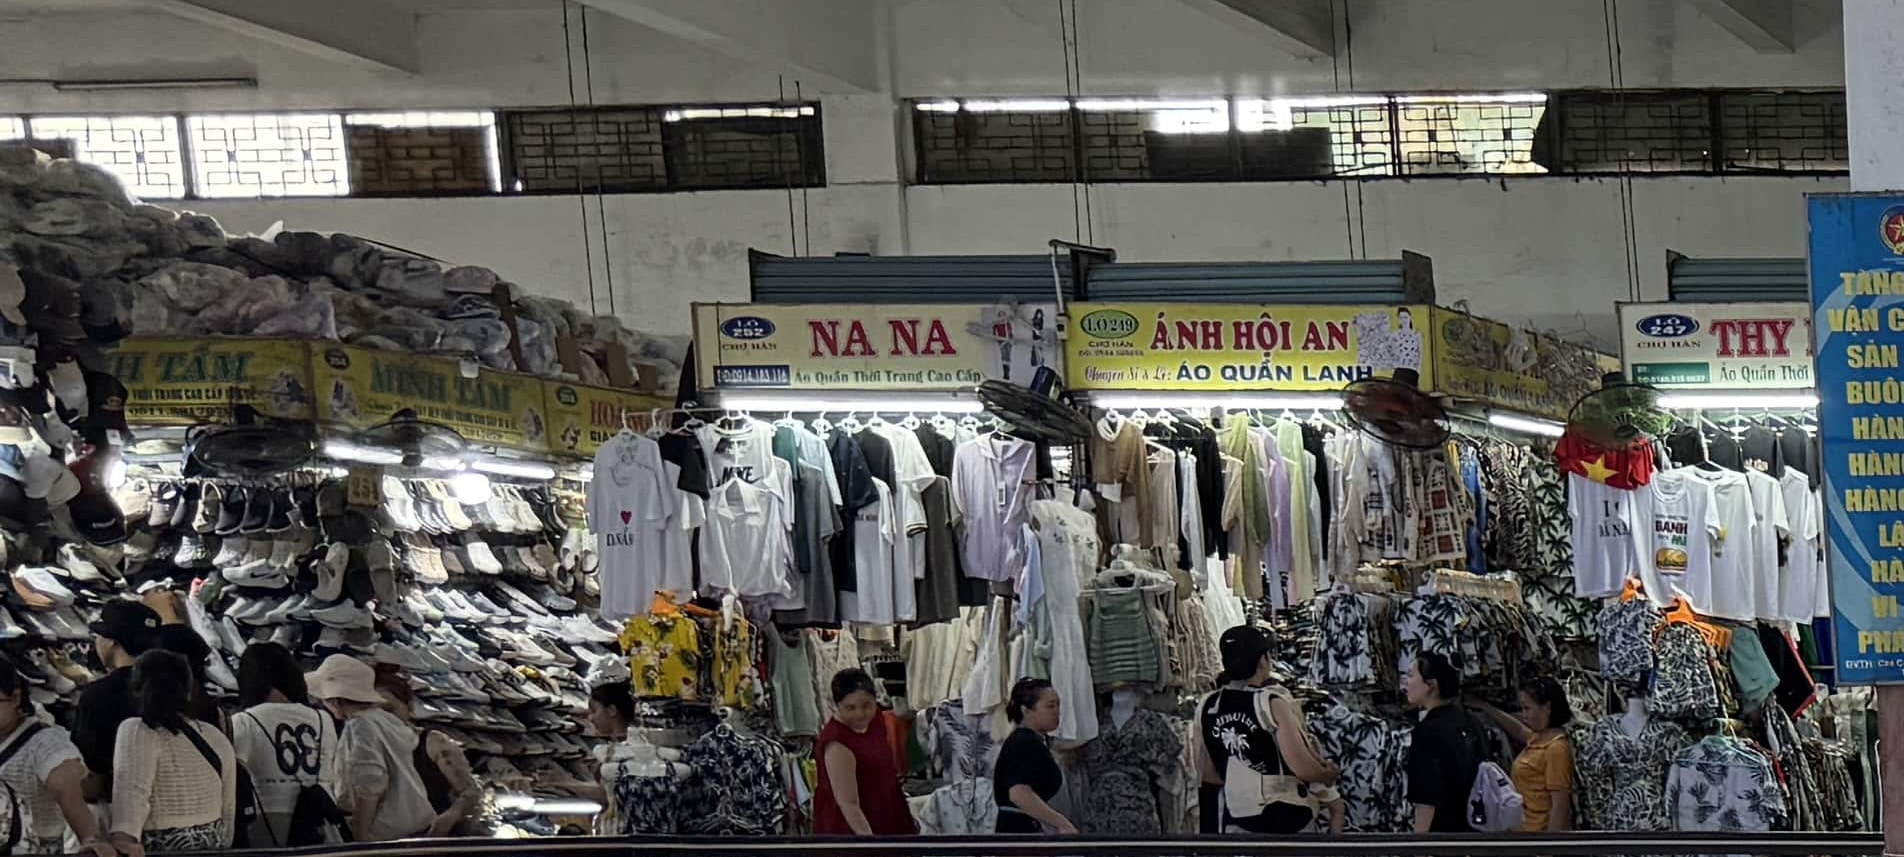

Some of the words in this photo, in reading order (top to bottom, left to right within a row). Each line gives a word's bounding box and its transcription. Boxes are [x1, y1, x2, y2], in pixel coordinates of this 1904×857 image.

[1233, 311, 1292, 358] HỘI
[1301, 320, 1350, 351] AN
[1650, 325, 1687, 335] 247
[1827, 304, 1880, 336] VẬN
[808, 319, 877, 358] NA
[889, 319, 959, 357] NA
[1709, 318, 1795, 358] THY
[1847, 339, 1898, 368] SẢN
[886, 369, 924, 385] Trang
[927, 370, 952, 383] Cao
[1176, 360, 1211, 381] ÁO
[1220, 357, 1297, 382] QUẦN
[1303, 365, 1372, 382] LANH
[1871, 595, 1899, 618] VI
